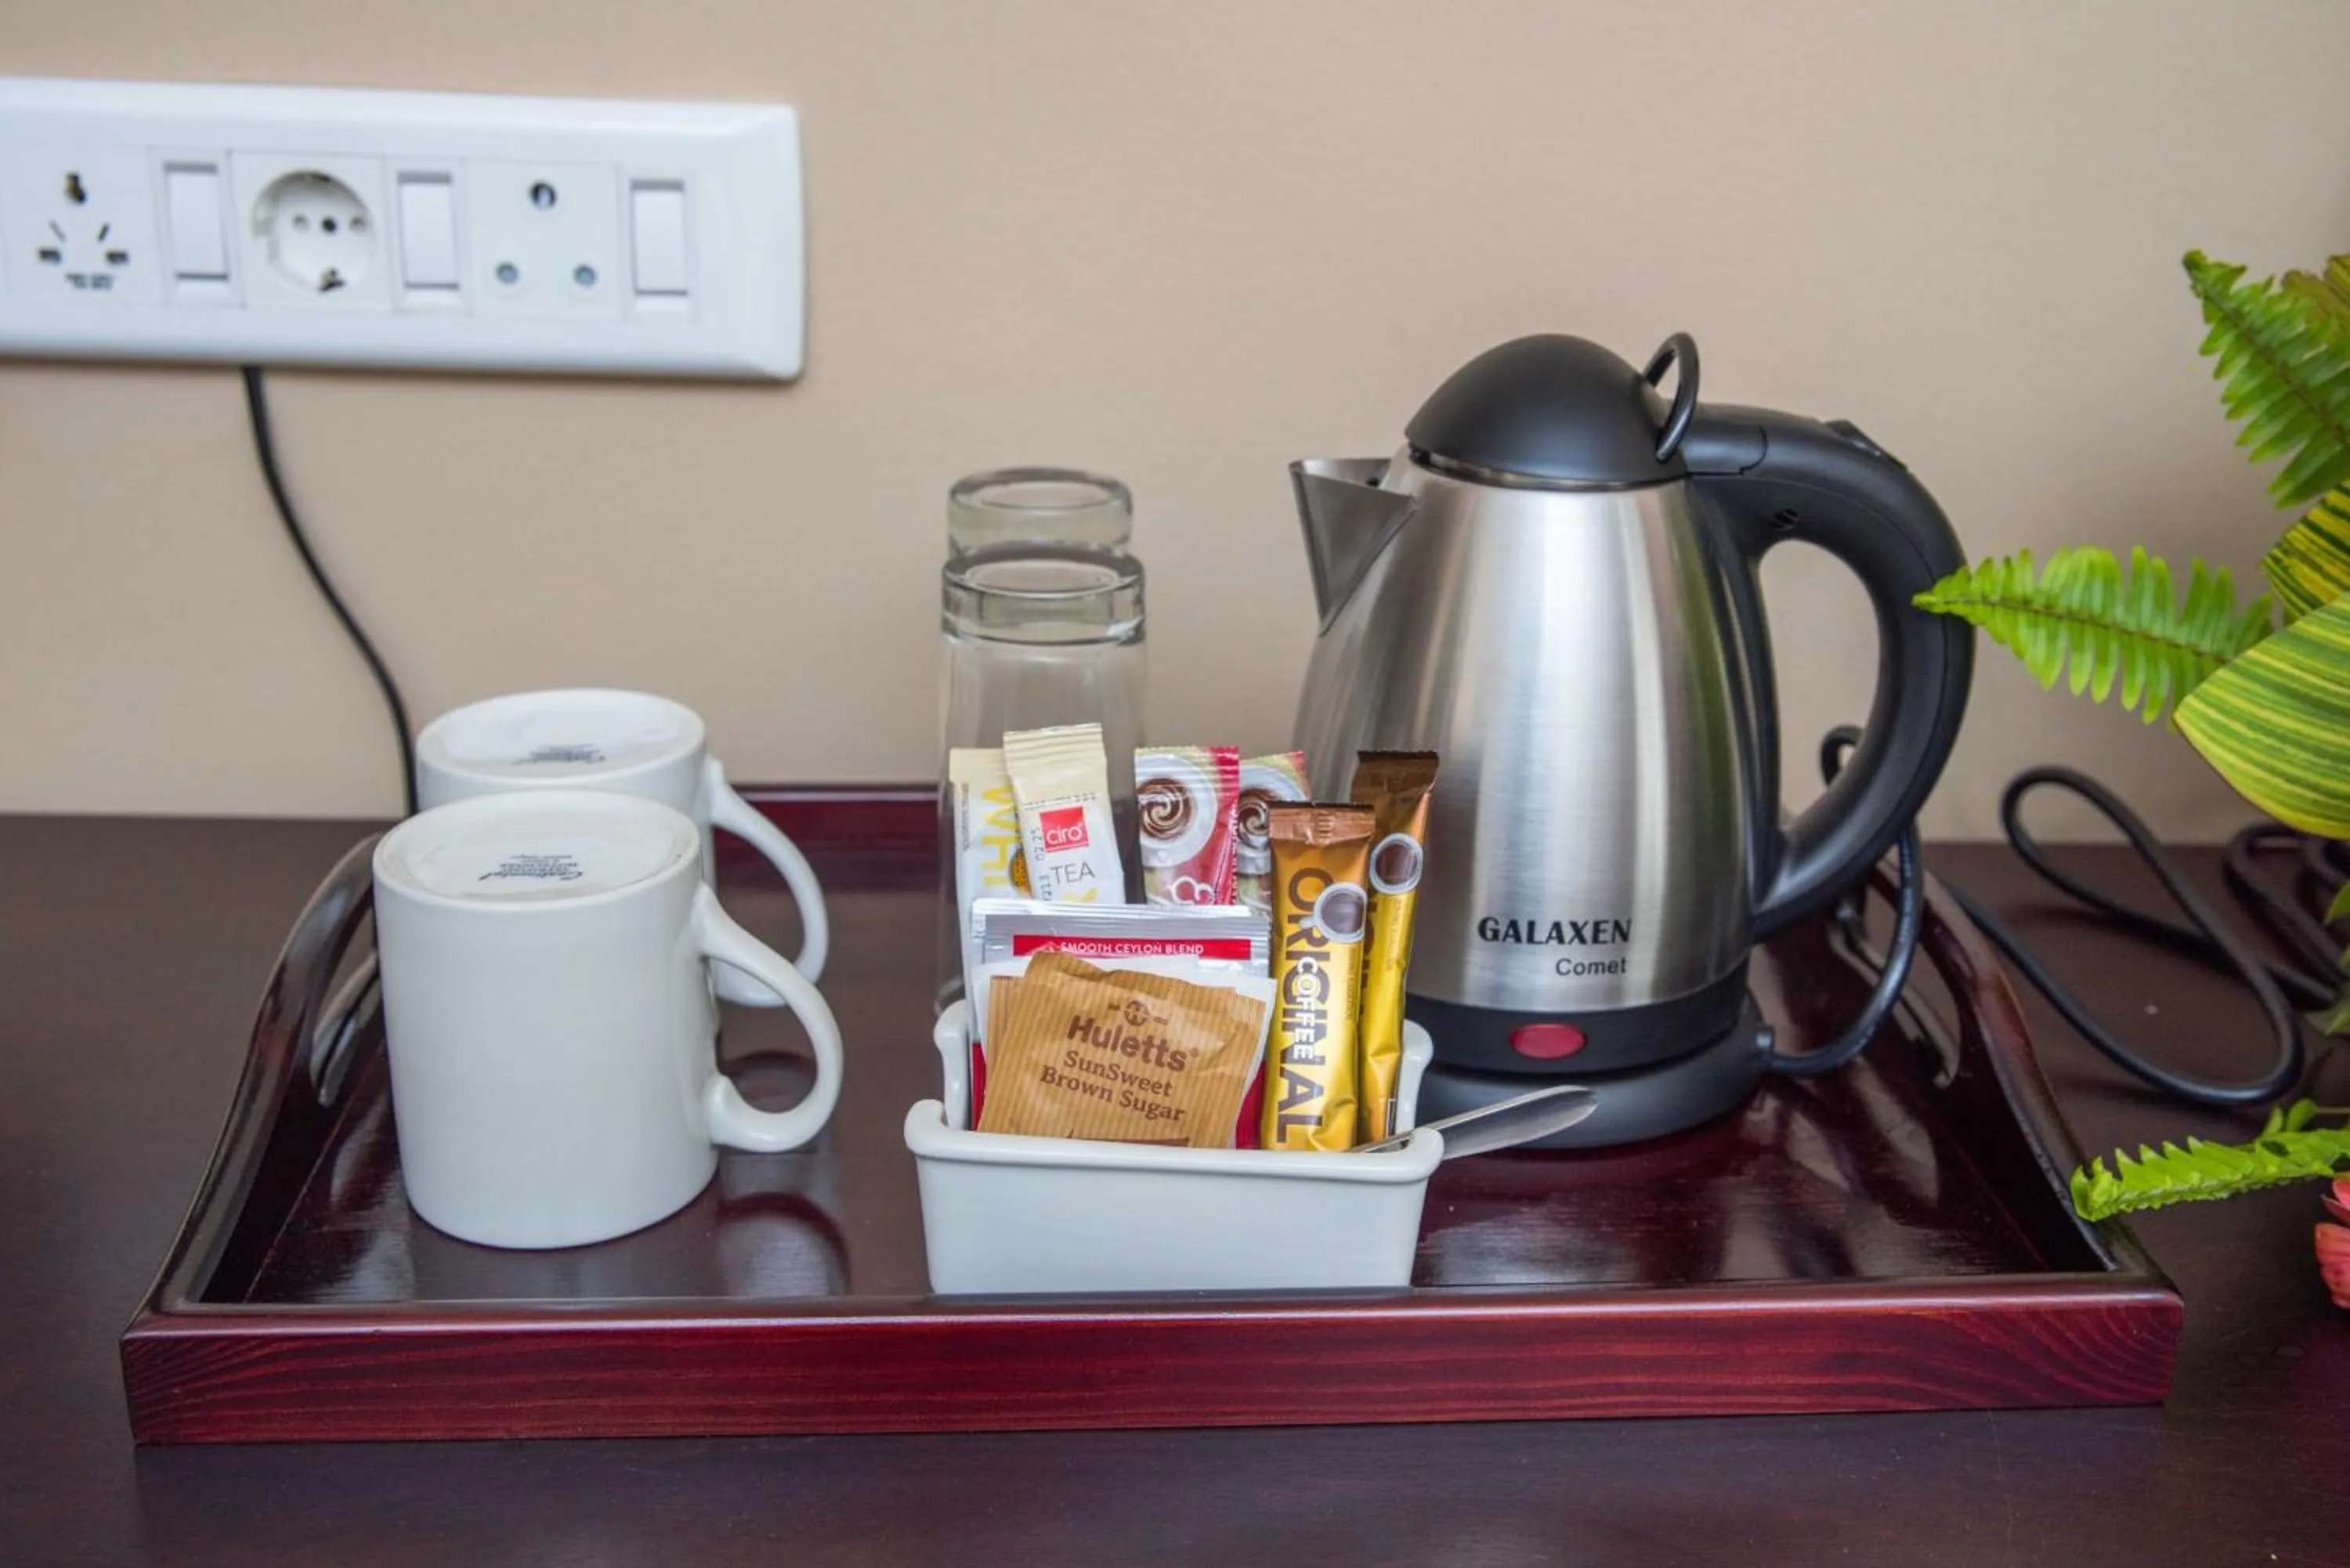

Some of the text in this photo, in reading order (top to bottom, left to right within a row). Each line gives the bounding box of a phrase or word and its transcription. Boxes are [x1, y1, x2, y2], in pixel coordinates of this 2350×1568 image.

[1046, 824, 1083, 846] ciro
[1050, 861, 1095, 885] TEA
[1477, 916, 1632, 945] GALAXEN
[1061, 941, 1205, 955] SMOOTH CEYLON BLEND
[1555, 957, 1628, 977] Comet
[1293, 956, 1321, 1060] COFFEE
[1066, 1014, 1188, 1073] Huletts
[1063, 1050, 1173, 1097] SunSweet
[1039, 1064, 1186, 1121] Brown Sugar
